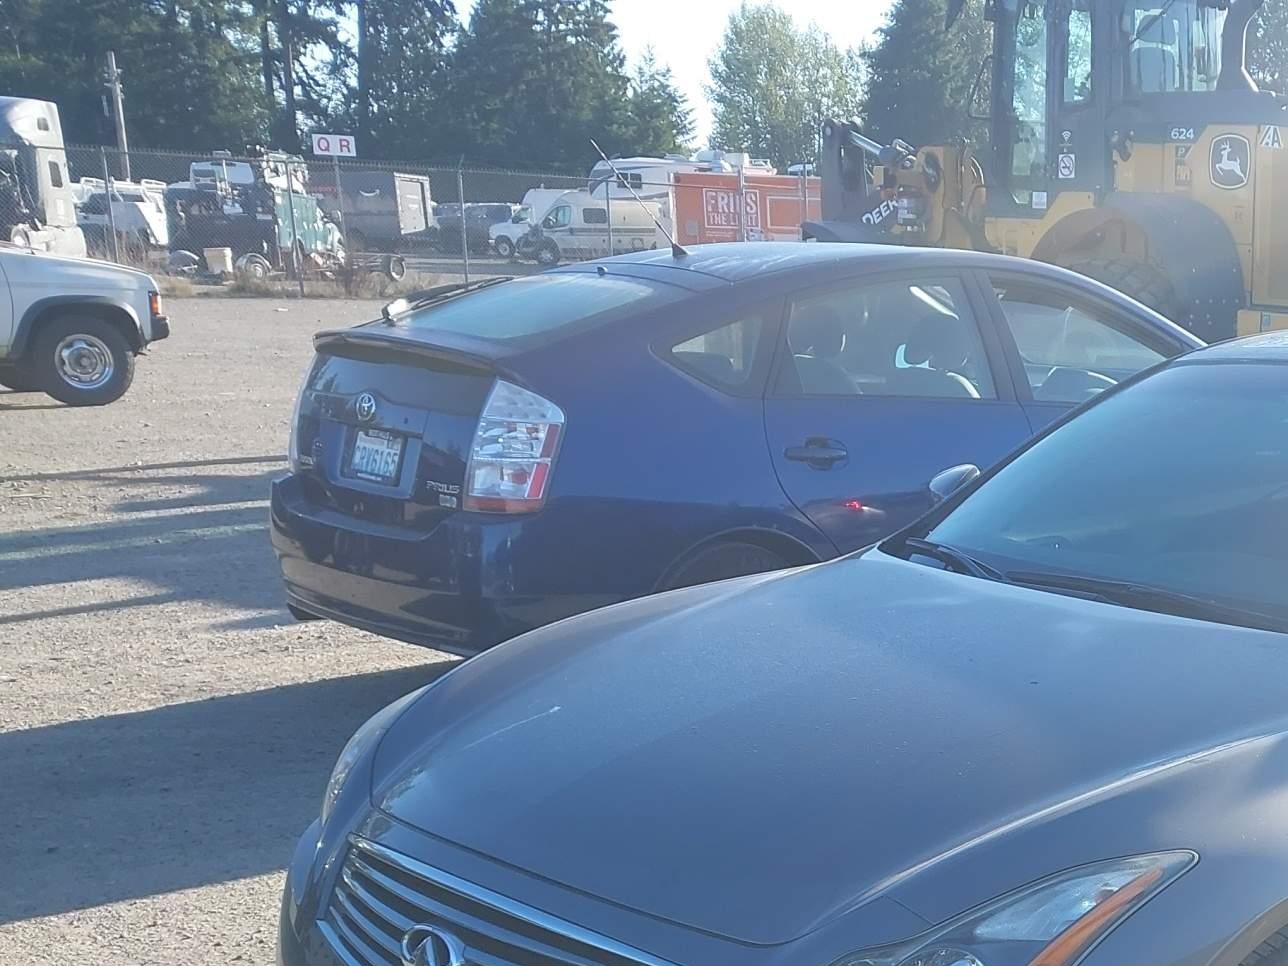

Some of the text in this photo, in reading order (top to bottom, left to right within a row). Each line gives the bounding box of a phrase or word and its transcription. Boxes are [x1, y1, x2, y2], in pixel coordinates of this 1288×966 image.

[1171, 128, 1195, 140] 624
[317, 136, 351, 153] Q R
[706, 191, 757, 213] FRIS
[708, 213, 757, 226] THE LIIT
